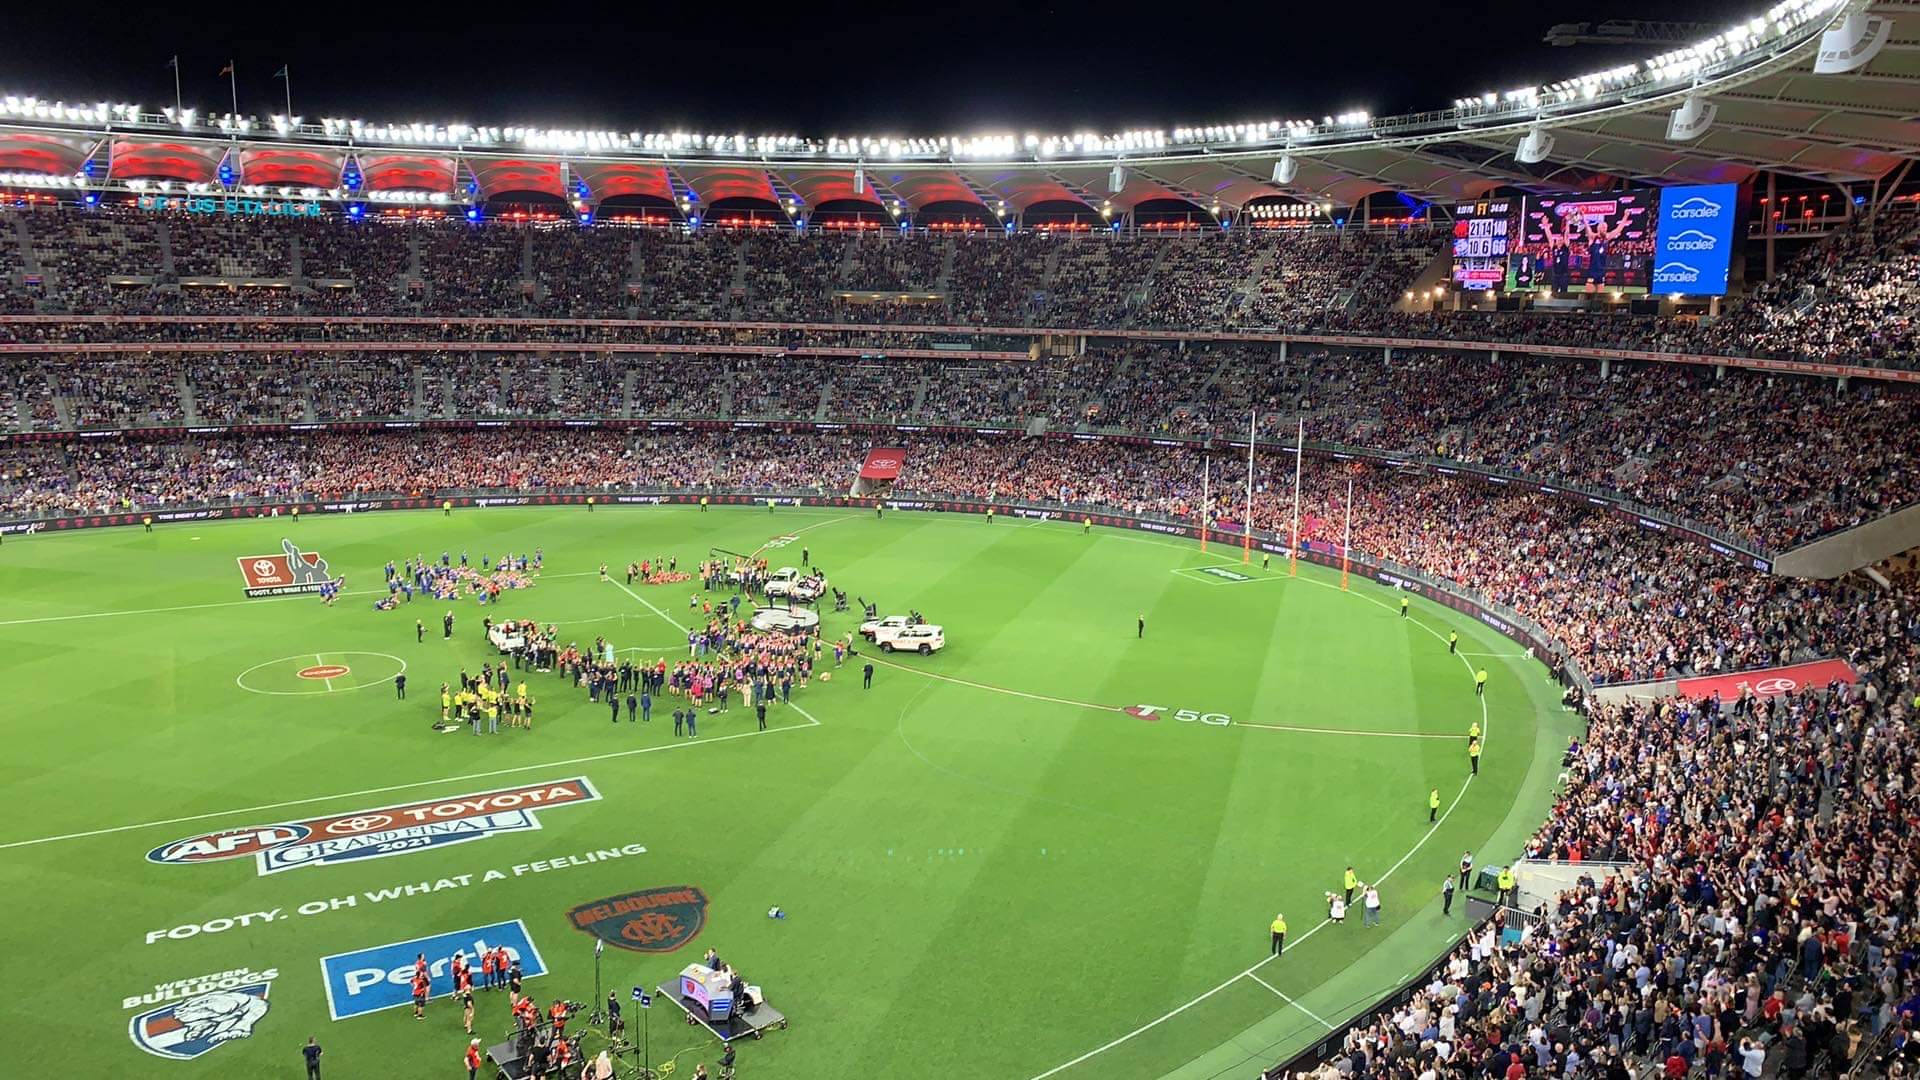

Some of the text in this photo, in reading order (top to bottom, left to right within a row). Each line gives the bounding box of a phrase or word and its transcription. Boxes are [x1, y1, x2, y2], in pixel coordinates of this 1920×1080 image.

[138, 196, 321, 217] OPTUS STADIUM
[1671, 206, 1719, 218] carsales
[1483, 220, 1492, 236] 14
[1482, 240, 1489, 254] 6
[1667, 239, 1714, 250] carsales
[1653, 271, 1698, 282] carsales
[1174, 709, 1232, 726] 5G
[161, 787, 577, 861] AFL TOYOTA
[274, 816, 525, 863] GRAND FINAL
[377, 836, 432, 853] 2021
[145, 843, 649, 944] FOOTY. OH WHAT A FEELING
[575, 889, 701, 926] MELBOURNE
[342, 938, 522, 996] Perth
[122, 968, 280, 1009] BULLDOGS
[154, 967, 249, 992] WESTERN
